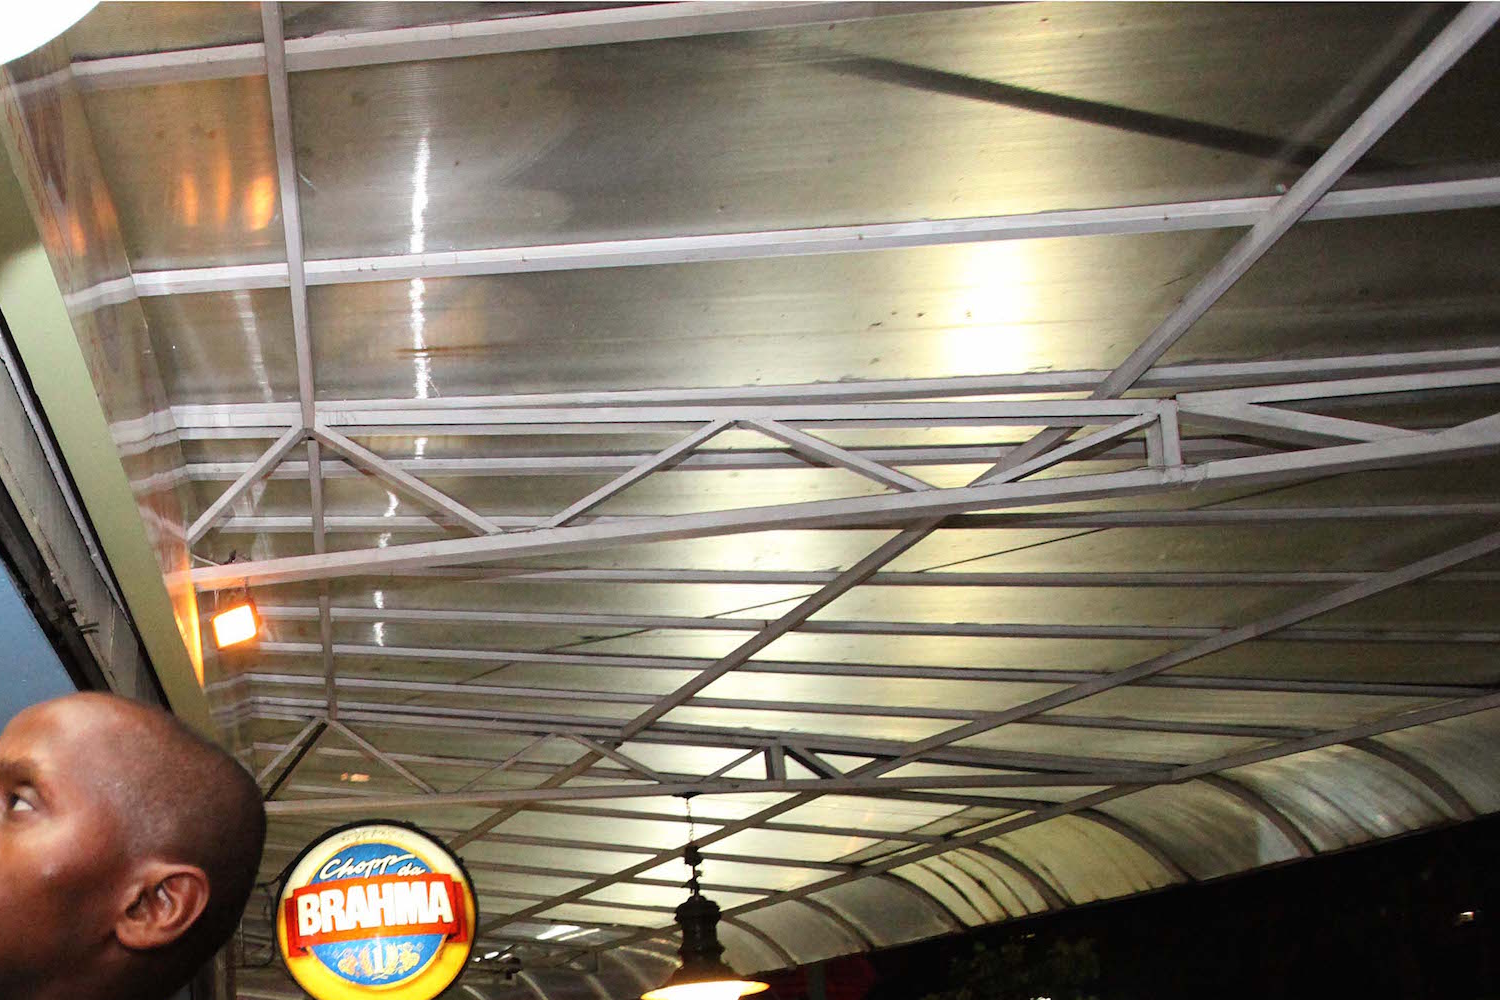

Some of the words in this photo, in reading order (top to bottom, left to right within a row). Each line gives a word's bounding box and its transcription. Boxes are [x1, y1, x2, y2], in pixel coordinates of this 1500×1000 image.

[319, 853, 417, 880] Chopp
[397, 862, 426, 877] da
[297, 881, 455, 937] BRAHMA
